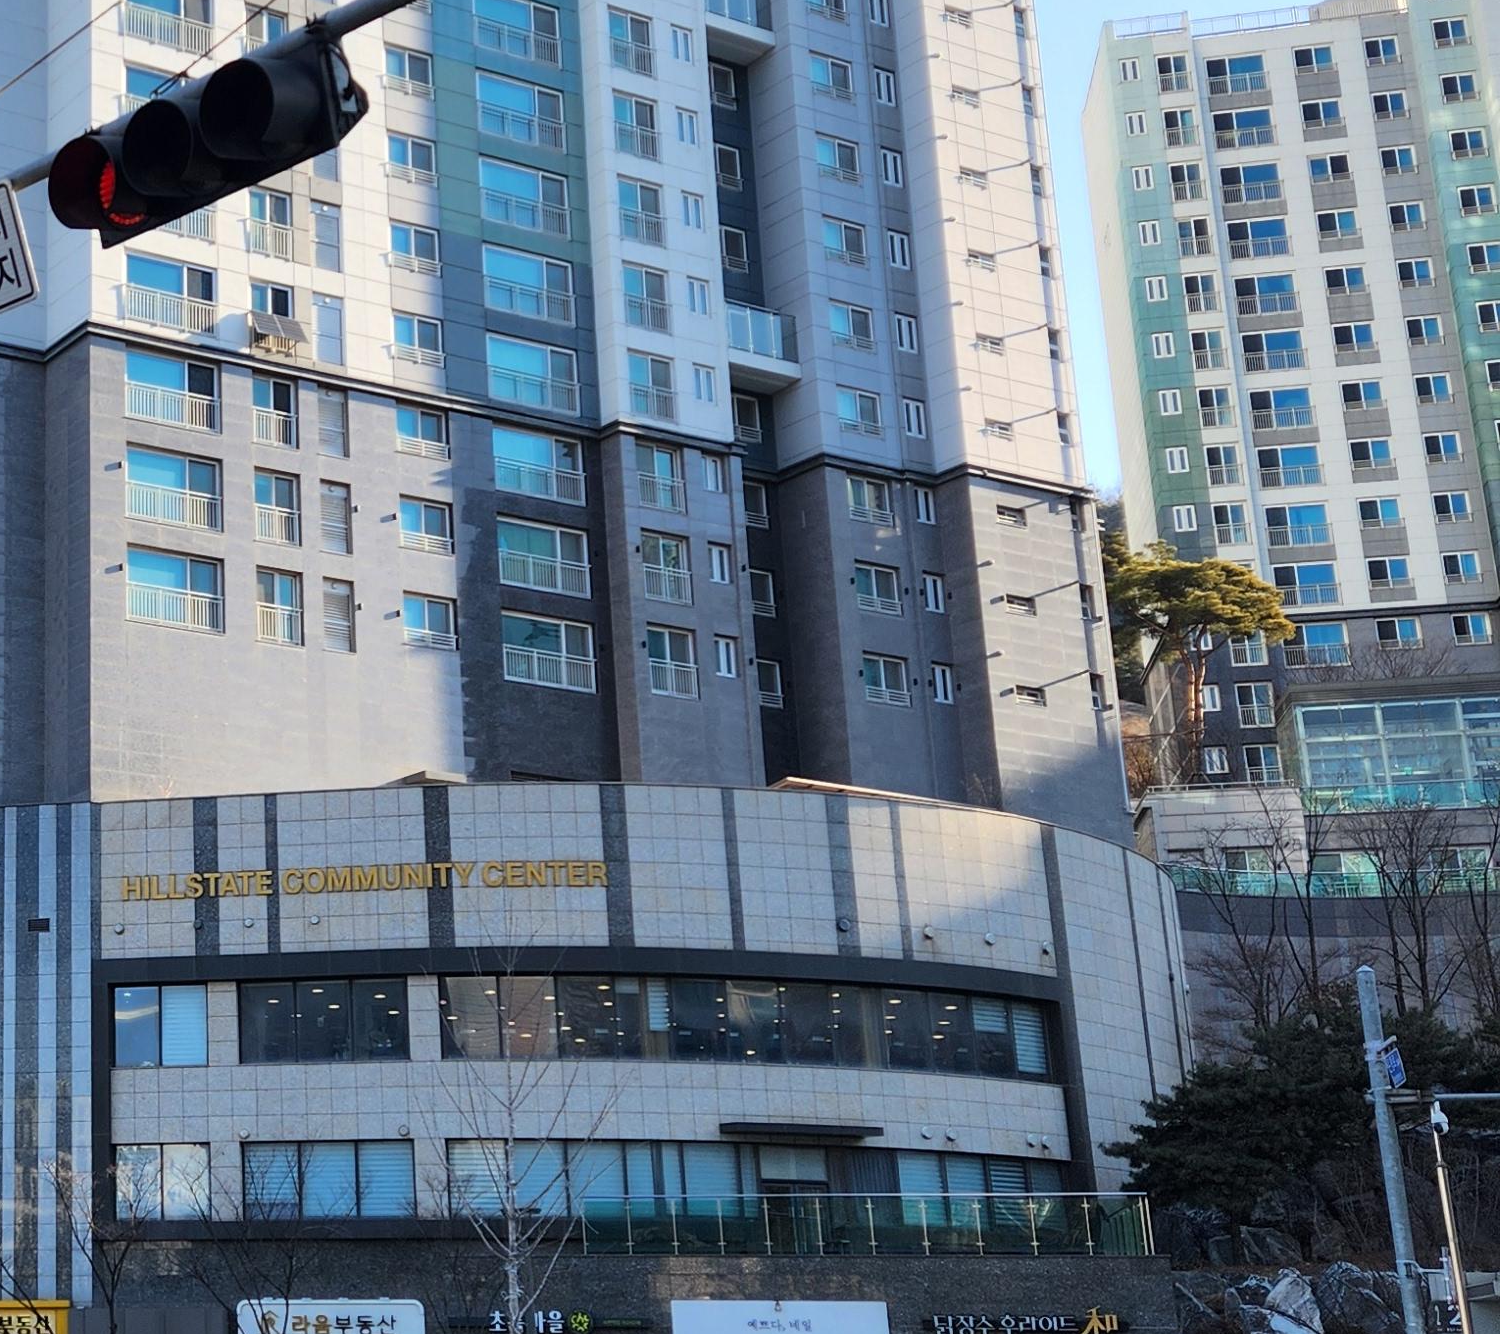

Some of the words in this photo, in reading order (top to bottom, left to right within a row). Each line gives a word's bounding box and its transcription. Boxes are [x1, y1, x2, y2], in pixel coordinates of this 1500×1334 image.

[122, 871, 273, 900] HILLSTATE
[282, 862, 476, 895] COMMUNITY
[482, 861, 608, 888] CENTER
